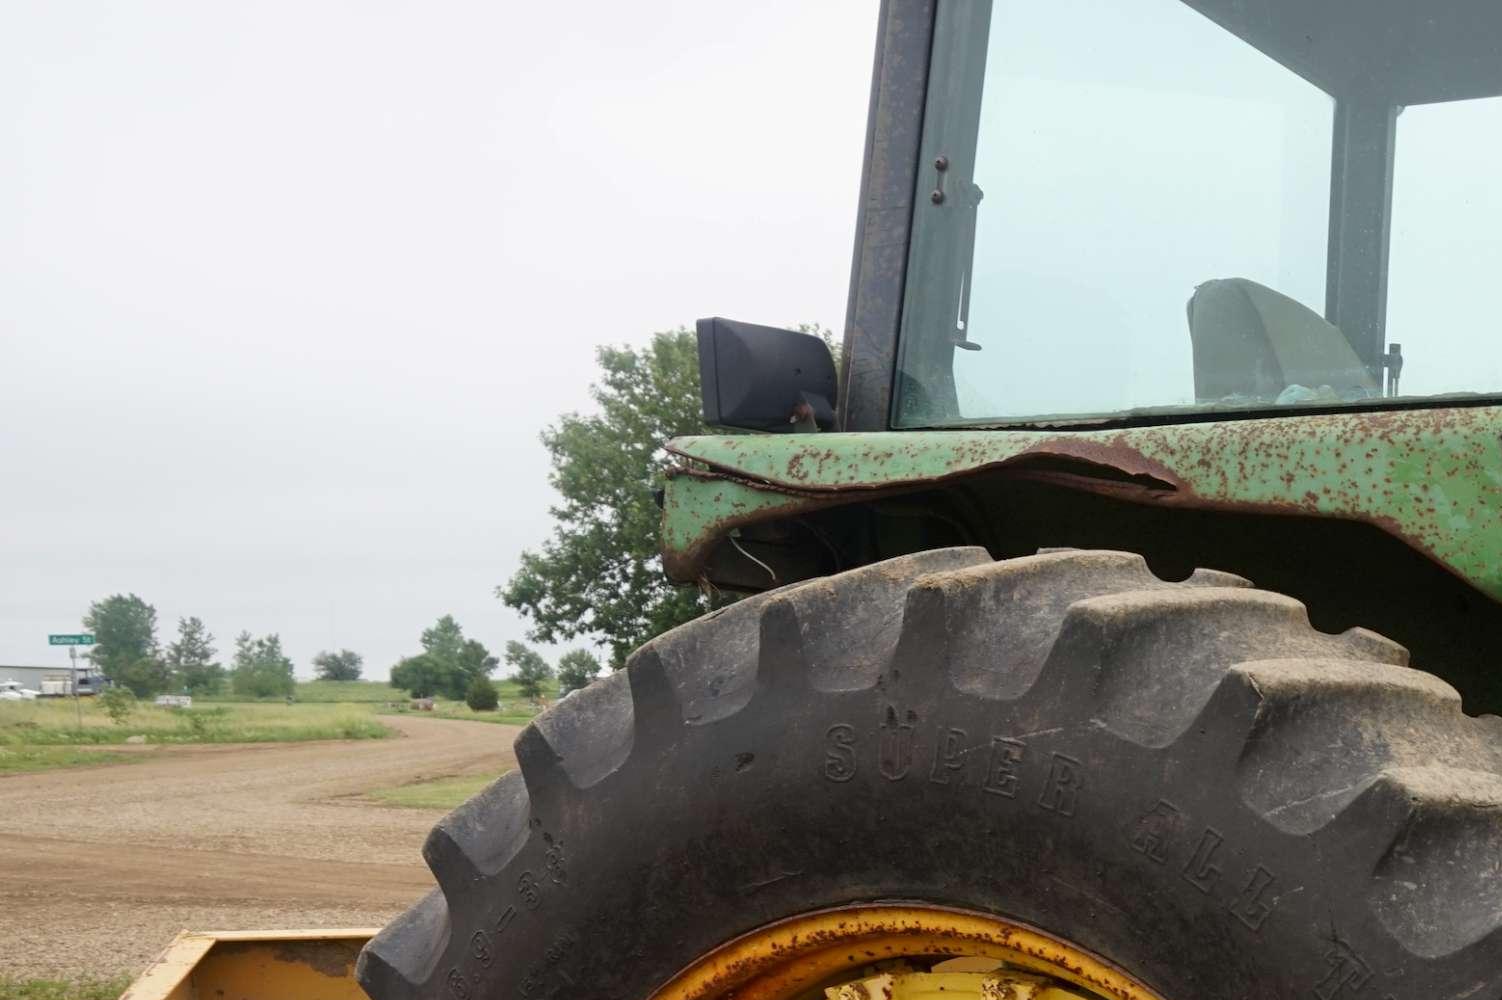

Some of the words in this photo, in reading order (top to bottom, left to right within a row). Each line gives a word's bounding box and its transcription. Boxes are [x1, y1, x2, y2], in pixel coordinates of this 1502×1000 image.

[82, 634, 92, 644] St
[824, 706, 1084, 817] SUPER
[1131, 797, 1284, 932] ALL
